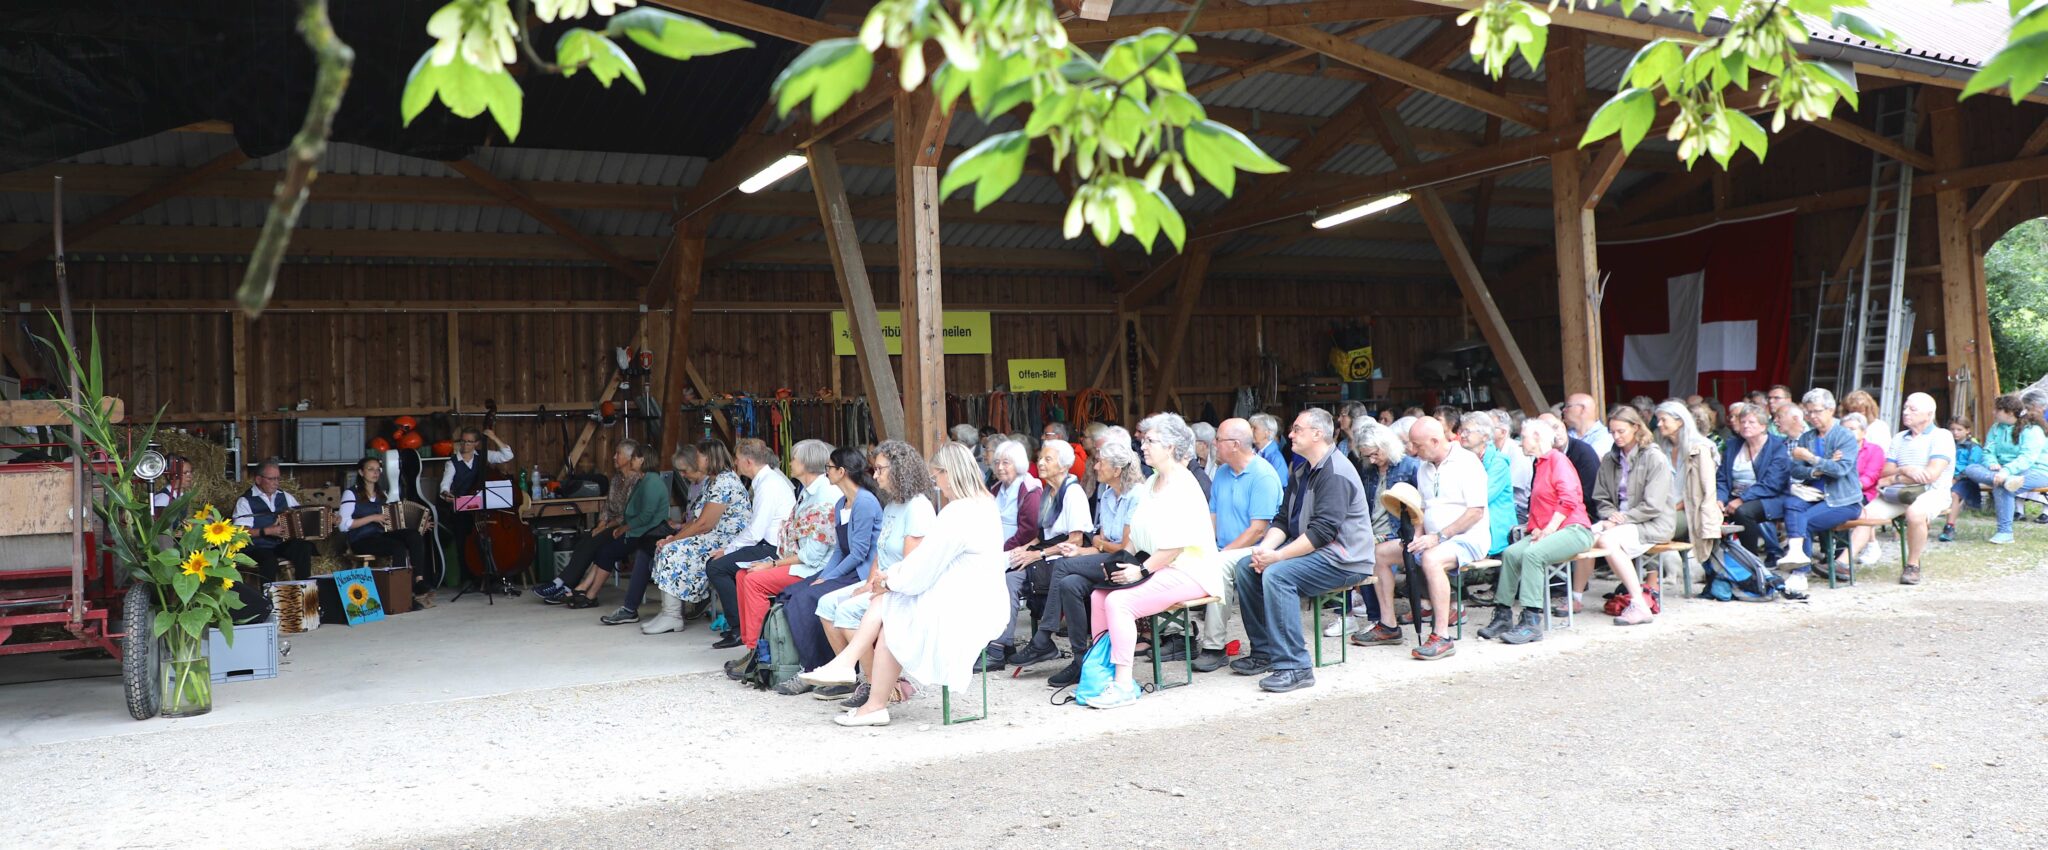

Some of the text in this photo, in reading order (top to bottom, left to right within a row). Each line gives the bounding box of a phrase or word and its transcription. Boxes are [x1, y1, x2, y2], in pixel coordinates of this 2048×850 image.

[881, 325, 972, 338] ribü meilen
[1018, 369, 1057, 379] Offen-Bier
